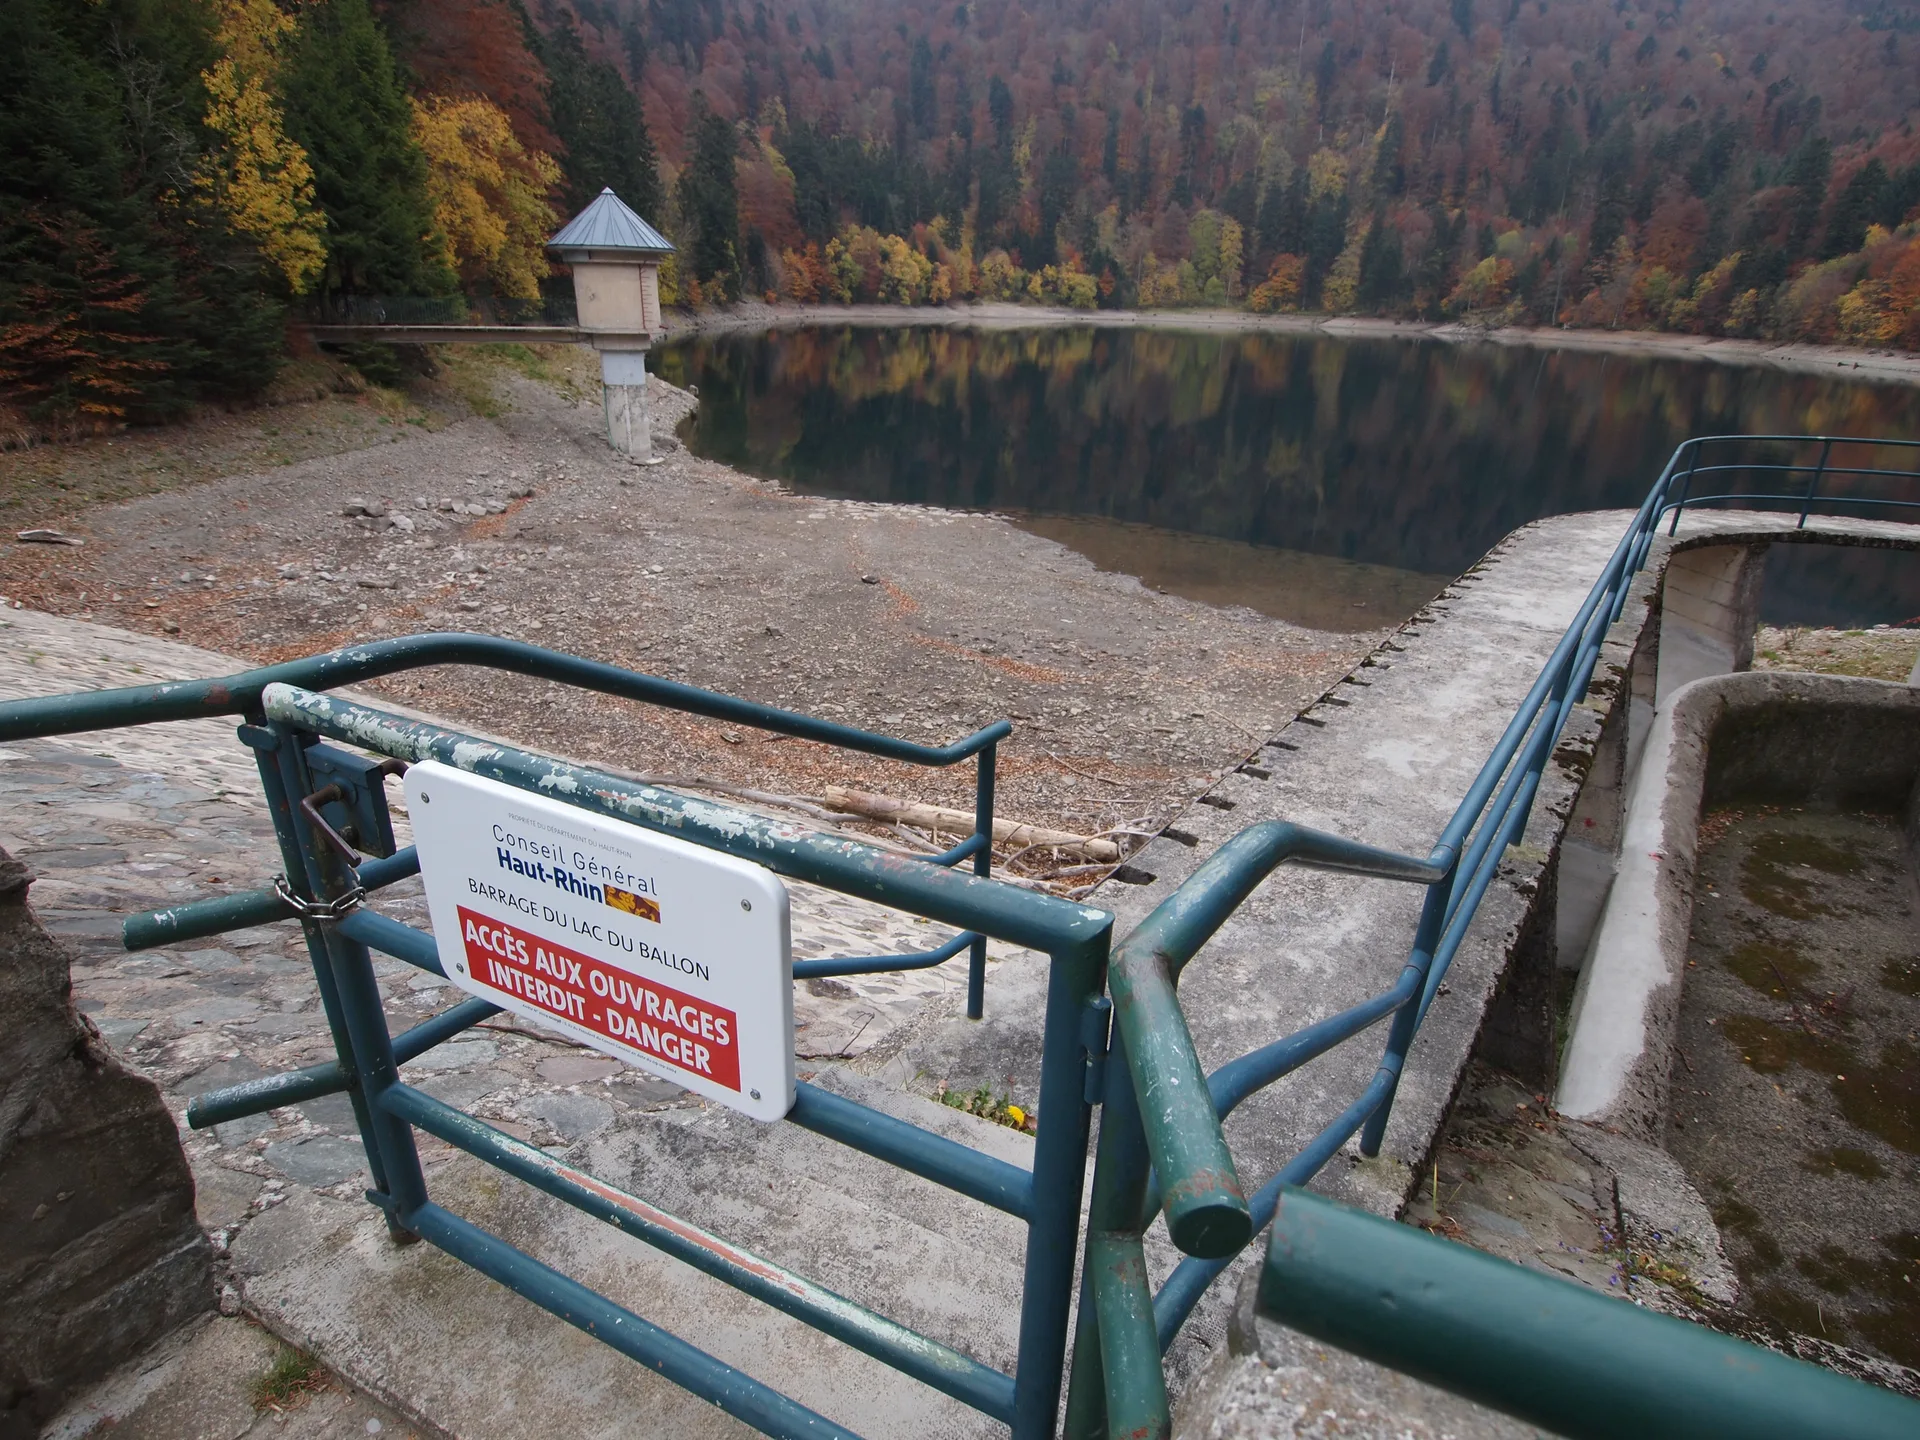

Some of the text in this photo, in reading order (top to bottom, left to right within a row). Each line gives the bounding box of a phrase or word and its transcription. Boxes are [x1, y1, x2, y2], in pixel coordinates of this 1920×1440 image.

[493, 824, 657, 896] Conseil Général
[497, 846, 603, 903] Haut-Rhin
[468, 877, 709, 981] BARRAGE DU LAC DU BALLON
[466, 919, 529, 965] ACCÈS
[535, 947, 585, 989] AUX
[589, 970, 730, 1046] OUVRAGES
[488, 958, 586, 1021] INTERDIT
[607, 1007, 712, 1074] DANGER
